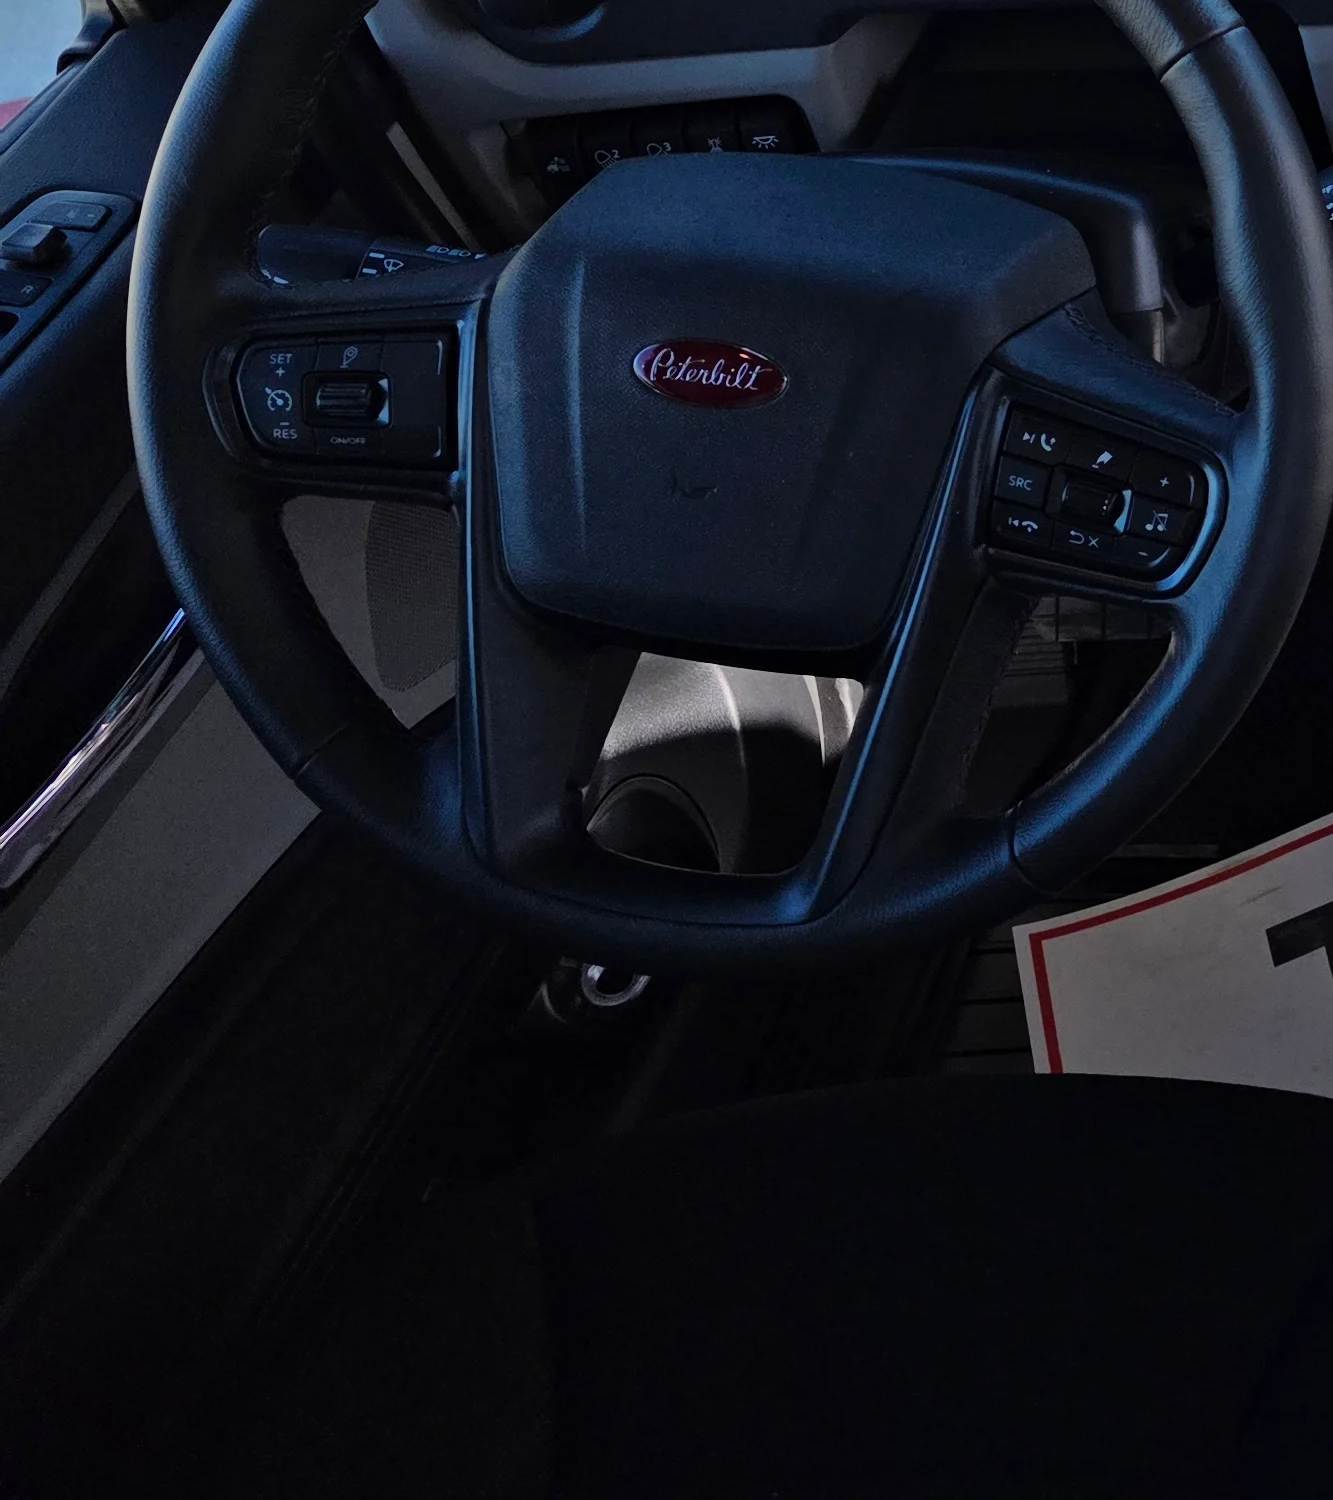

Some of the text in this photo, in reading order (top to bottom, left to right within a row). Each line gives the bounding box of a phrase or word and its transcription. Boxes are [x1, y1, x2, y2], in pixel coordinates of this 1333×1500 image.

[662, 142, 672, 152] 3
[611, 149, 621, 159] 2
[269, 353, 292, 365] SET
[650, 355, 764, 392] Peterbilt
[273, 428, 298, 440] RES
[1008, 475, 1033, 491] SRC
